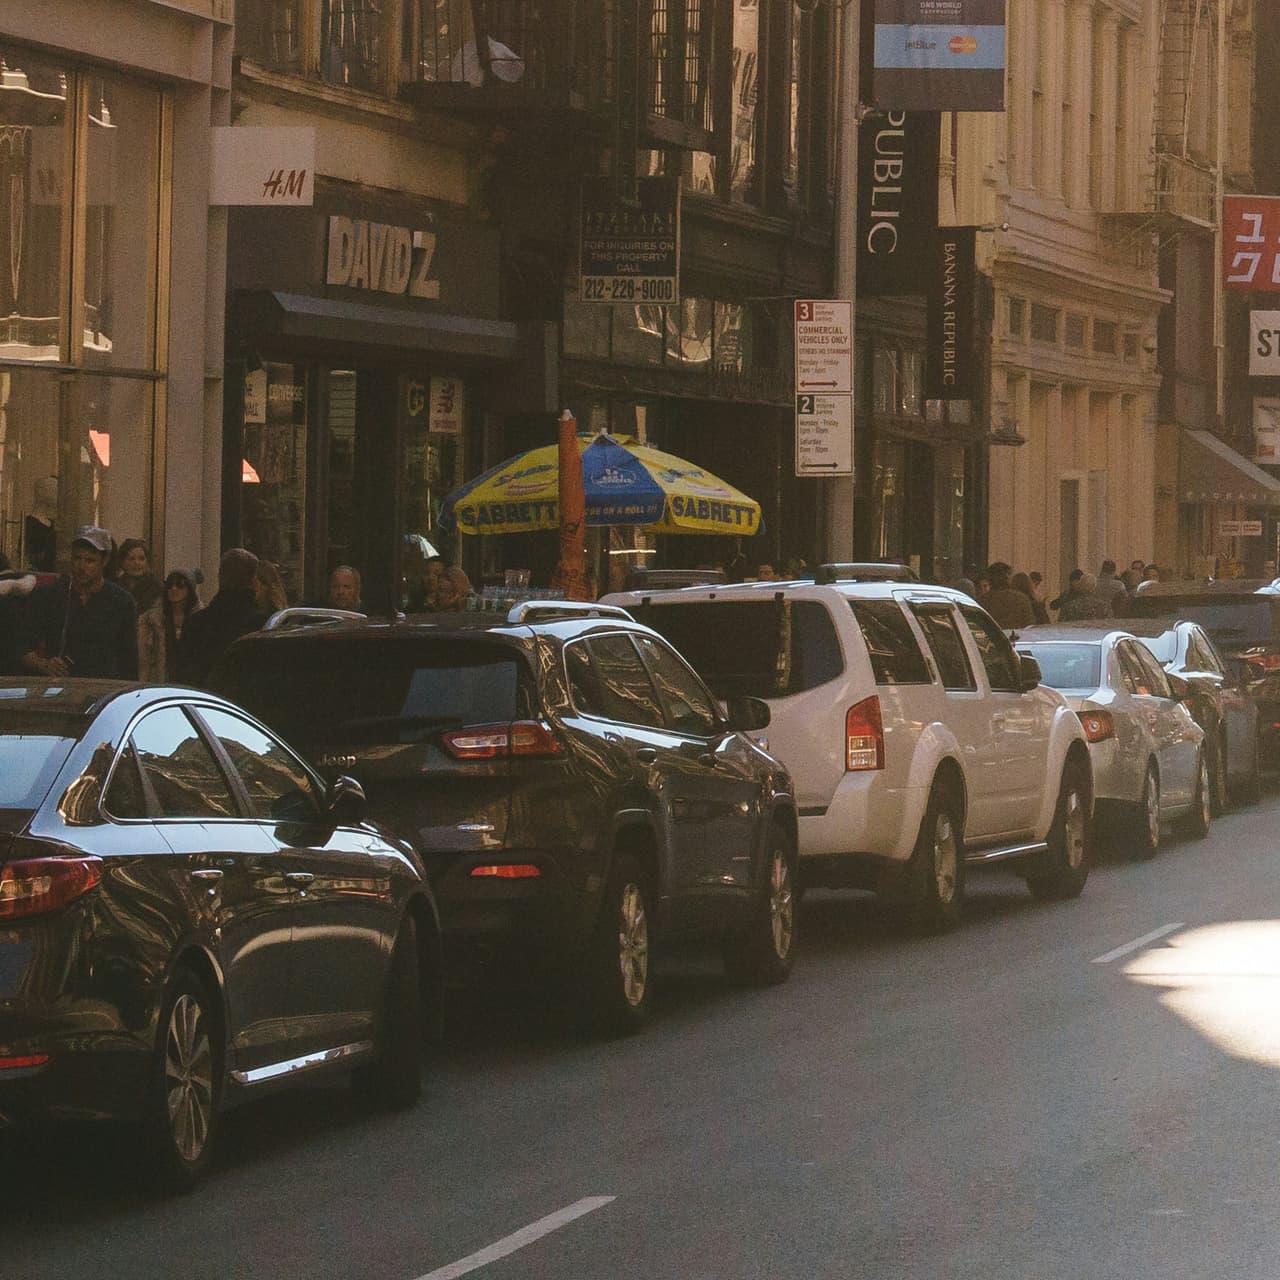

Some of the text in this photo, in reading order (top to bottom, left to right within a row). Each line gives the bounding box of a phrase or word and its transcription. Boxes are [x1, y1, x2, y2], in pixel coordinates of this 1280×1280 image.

[262, 169, 307, 199] H&M
[584, 241, 674, 250] FOR INQUIRIES ON
[591, 253, 667, 261] THIS PROPERTY
[616, 263, 641, 273] CALL
[799, 303, 809, 320] 3
[943, 242, 957, 385] BANANA REPUBLIC
[798, 326, 844, 335] COMMERCIAL
[798, 335, 848, 345] VEHICLES ONLY
[800, 396, 811, 413] 2
[672, 494, 757, 526] SABRETT
[320, 754, 357, 769] Jeep
